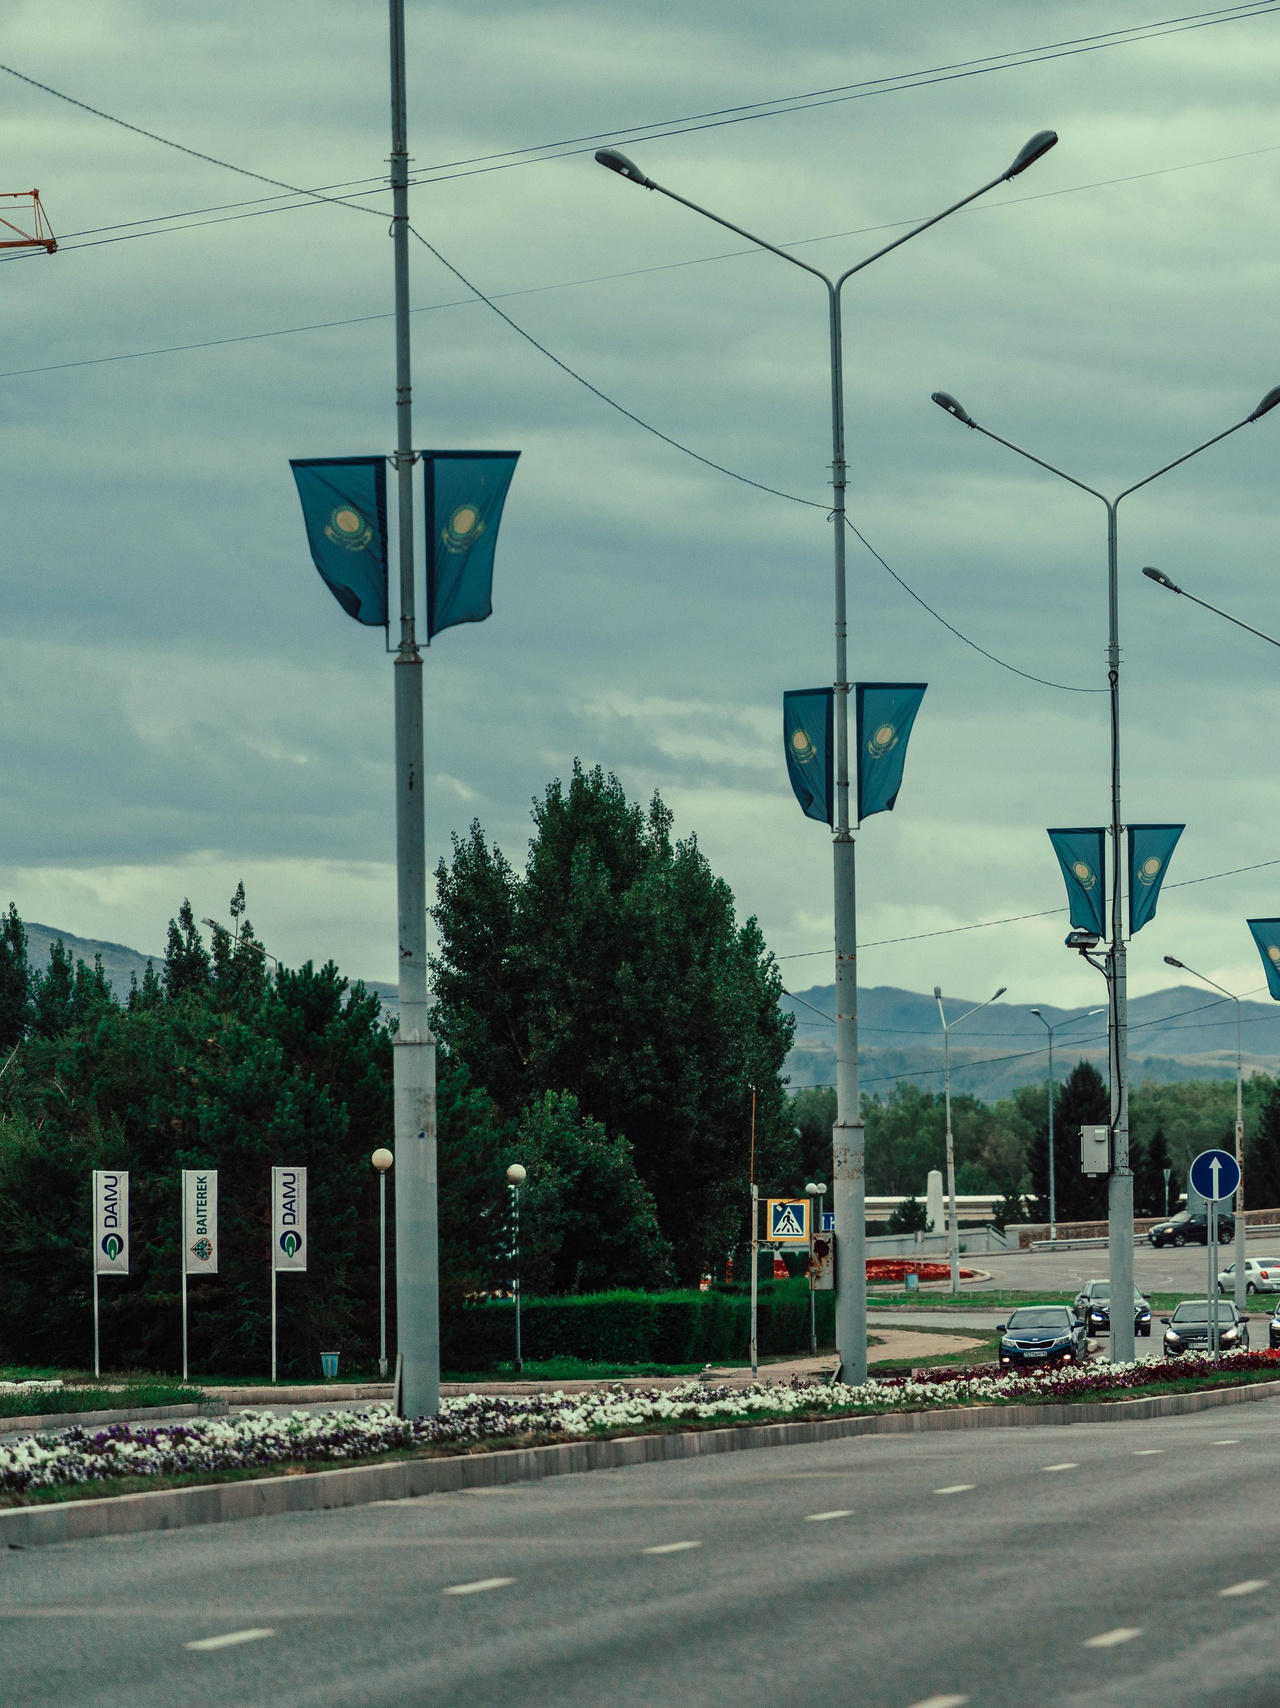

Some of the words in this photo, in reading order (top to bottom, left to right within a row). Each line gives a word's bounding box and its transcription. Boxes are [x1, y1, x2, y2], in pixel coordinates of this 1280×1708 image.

[104, 1175, 118, 1228] DAMU
[196, 1176, 207, 1235] BAITEREK
[282, 1173, 296, 1225] DAMU
